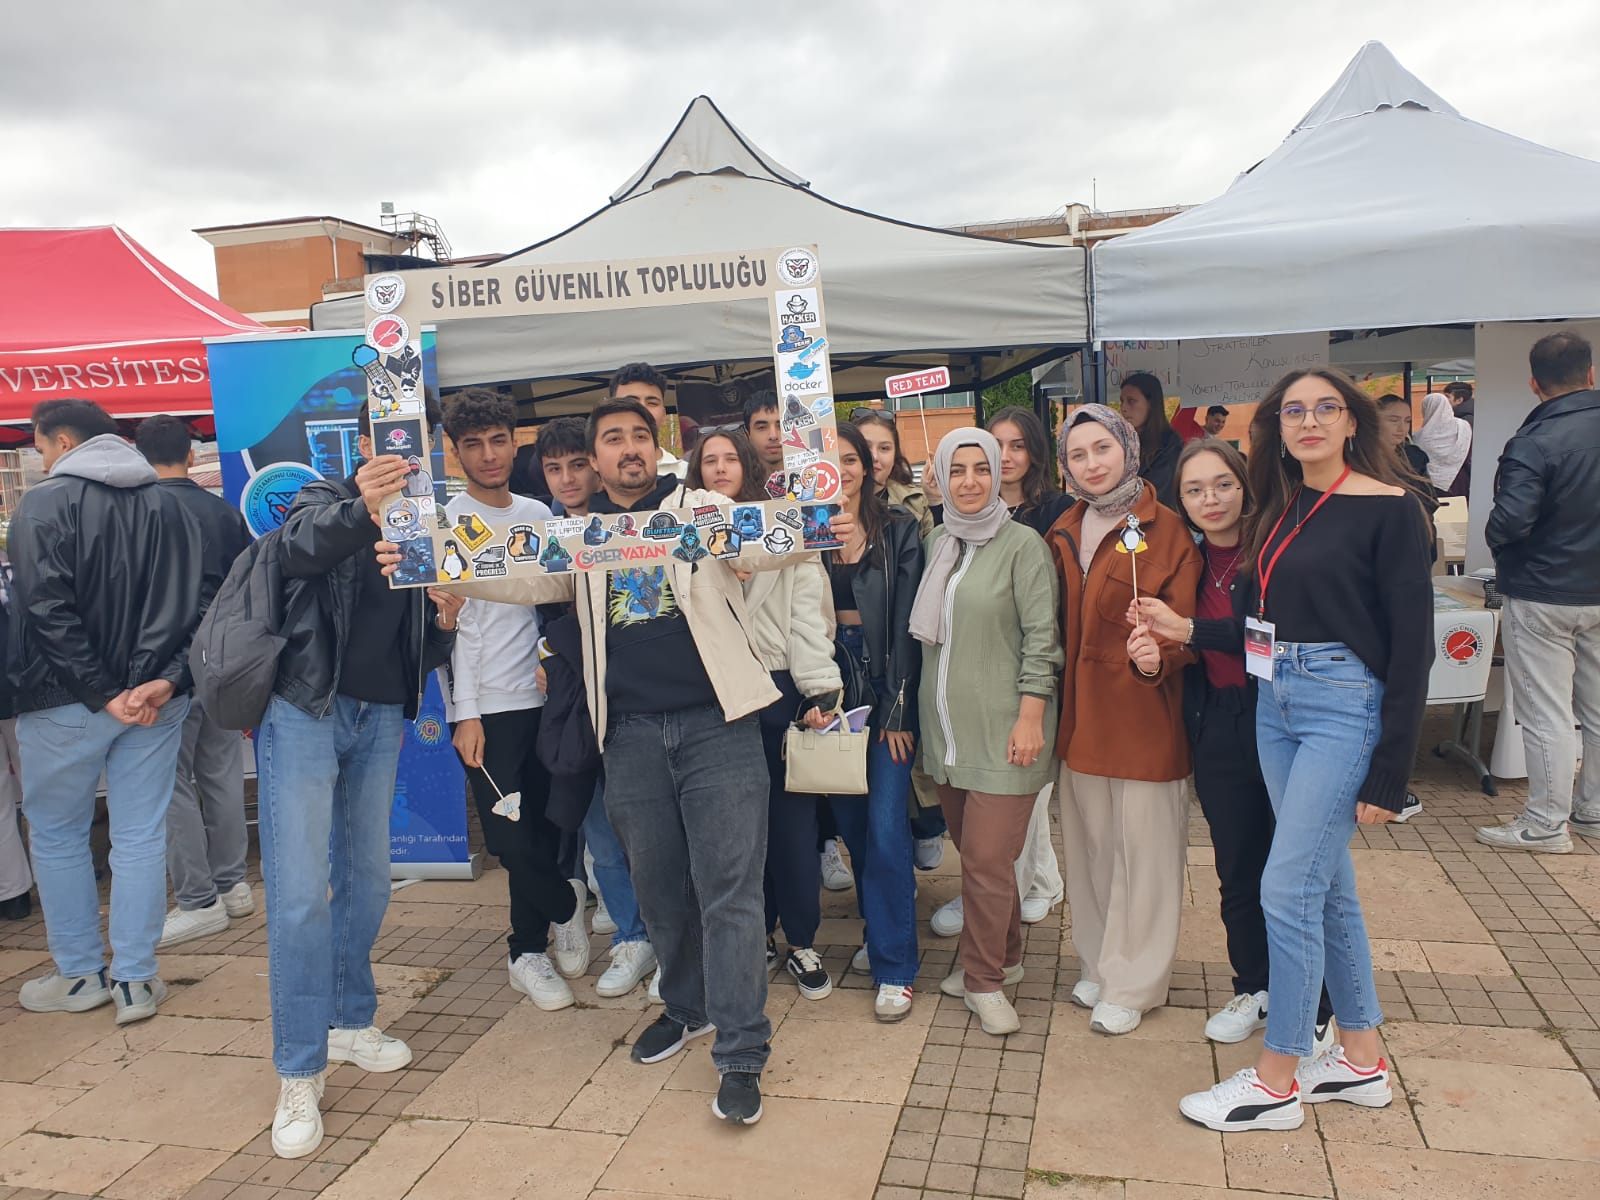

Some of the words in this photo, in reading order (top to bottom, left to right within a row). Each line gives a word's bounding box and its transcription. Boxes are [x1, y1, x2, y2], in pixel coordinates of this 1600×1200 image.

[431, 275, 502, 309] SİBER
[515, 265, 632, 301] GÜVENLİK
[637, 255, 768, 293] TOPLULUĞU
[781, 312, 816, 325] HACKER
[0, 357, 210, 393] VERSİTES
[892, 380, 913, 392] RED
[915, 373, 943, 387] TEAM
[784, 380, 822, 391] docker
